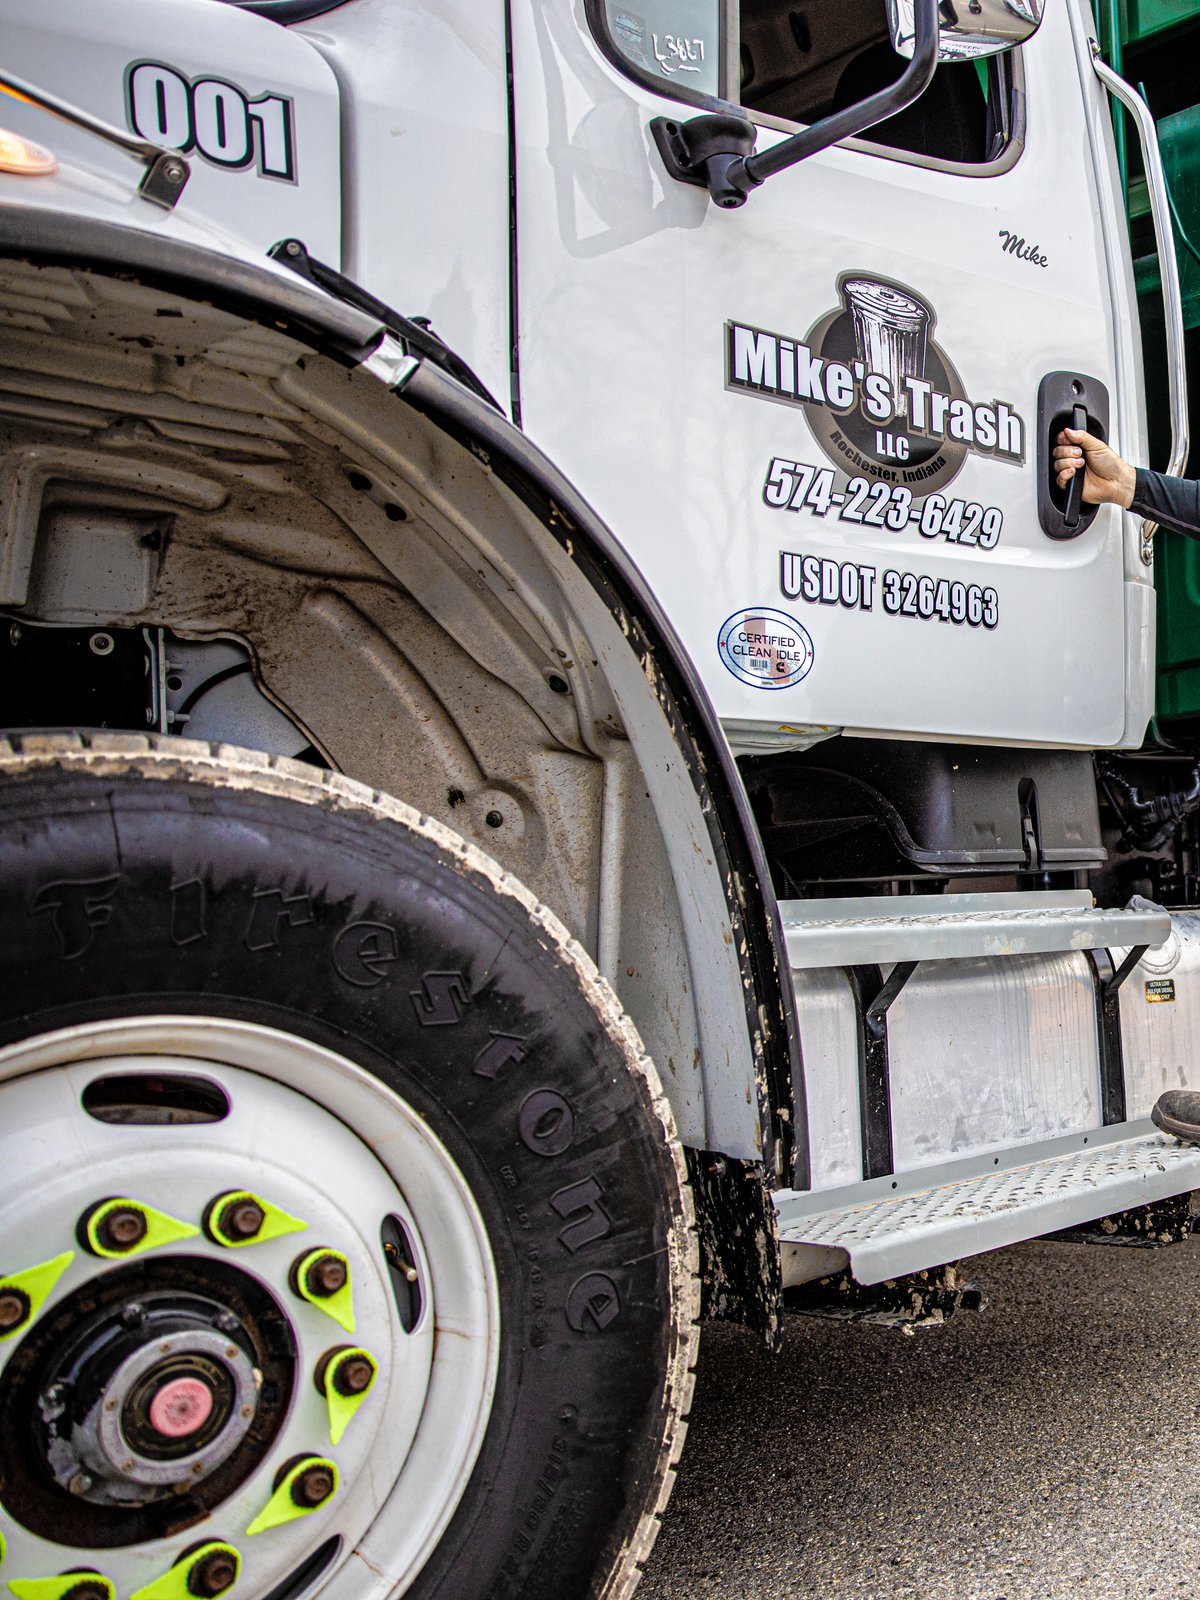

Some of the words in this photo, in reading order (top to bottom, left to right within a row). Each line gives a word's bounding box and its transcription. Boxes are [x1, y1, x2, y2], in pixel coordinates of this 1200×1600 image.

[124, 58, 298, 186] 001
[999, 230, 1048, 268] Mike
[731, 323, 895, 421] Mike's
[903, 375, 1023, 457] Trash
[830, 430, 899, 483] Rochester,
[902, 456, 947, 483] Indiana
[876, 430, 909, 460] LLC
[763, 457, 1004, 551] 574-223-6429
[780, 551, 876, 612] USDOT
[883, 570, 999, 630] 3264963
[732, 645, 772, 659] CLEAN
[776, 650, 801, 662] IDLE
[738, 632, 796, 648] CERTIFIED
